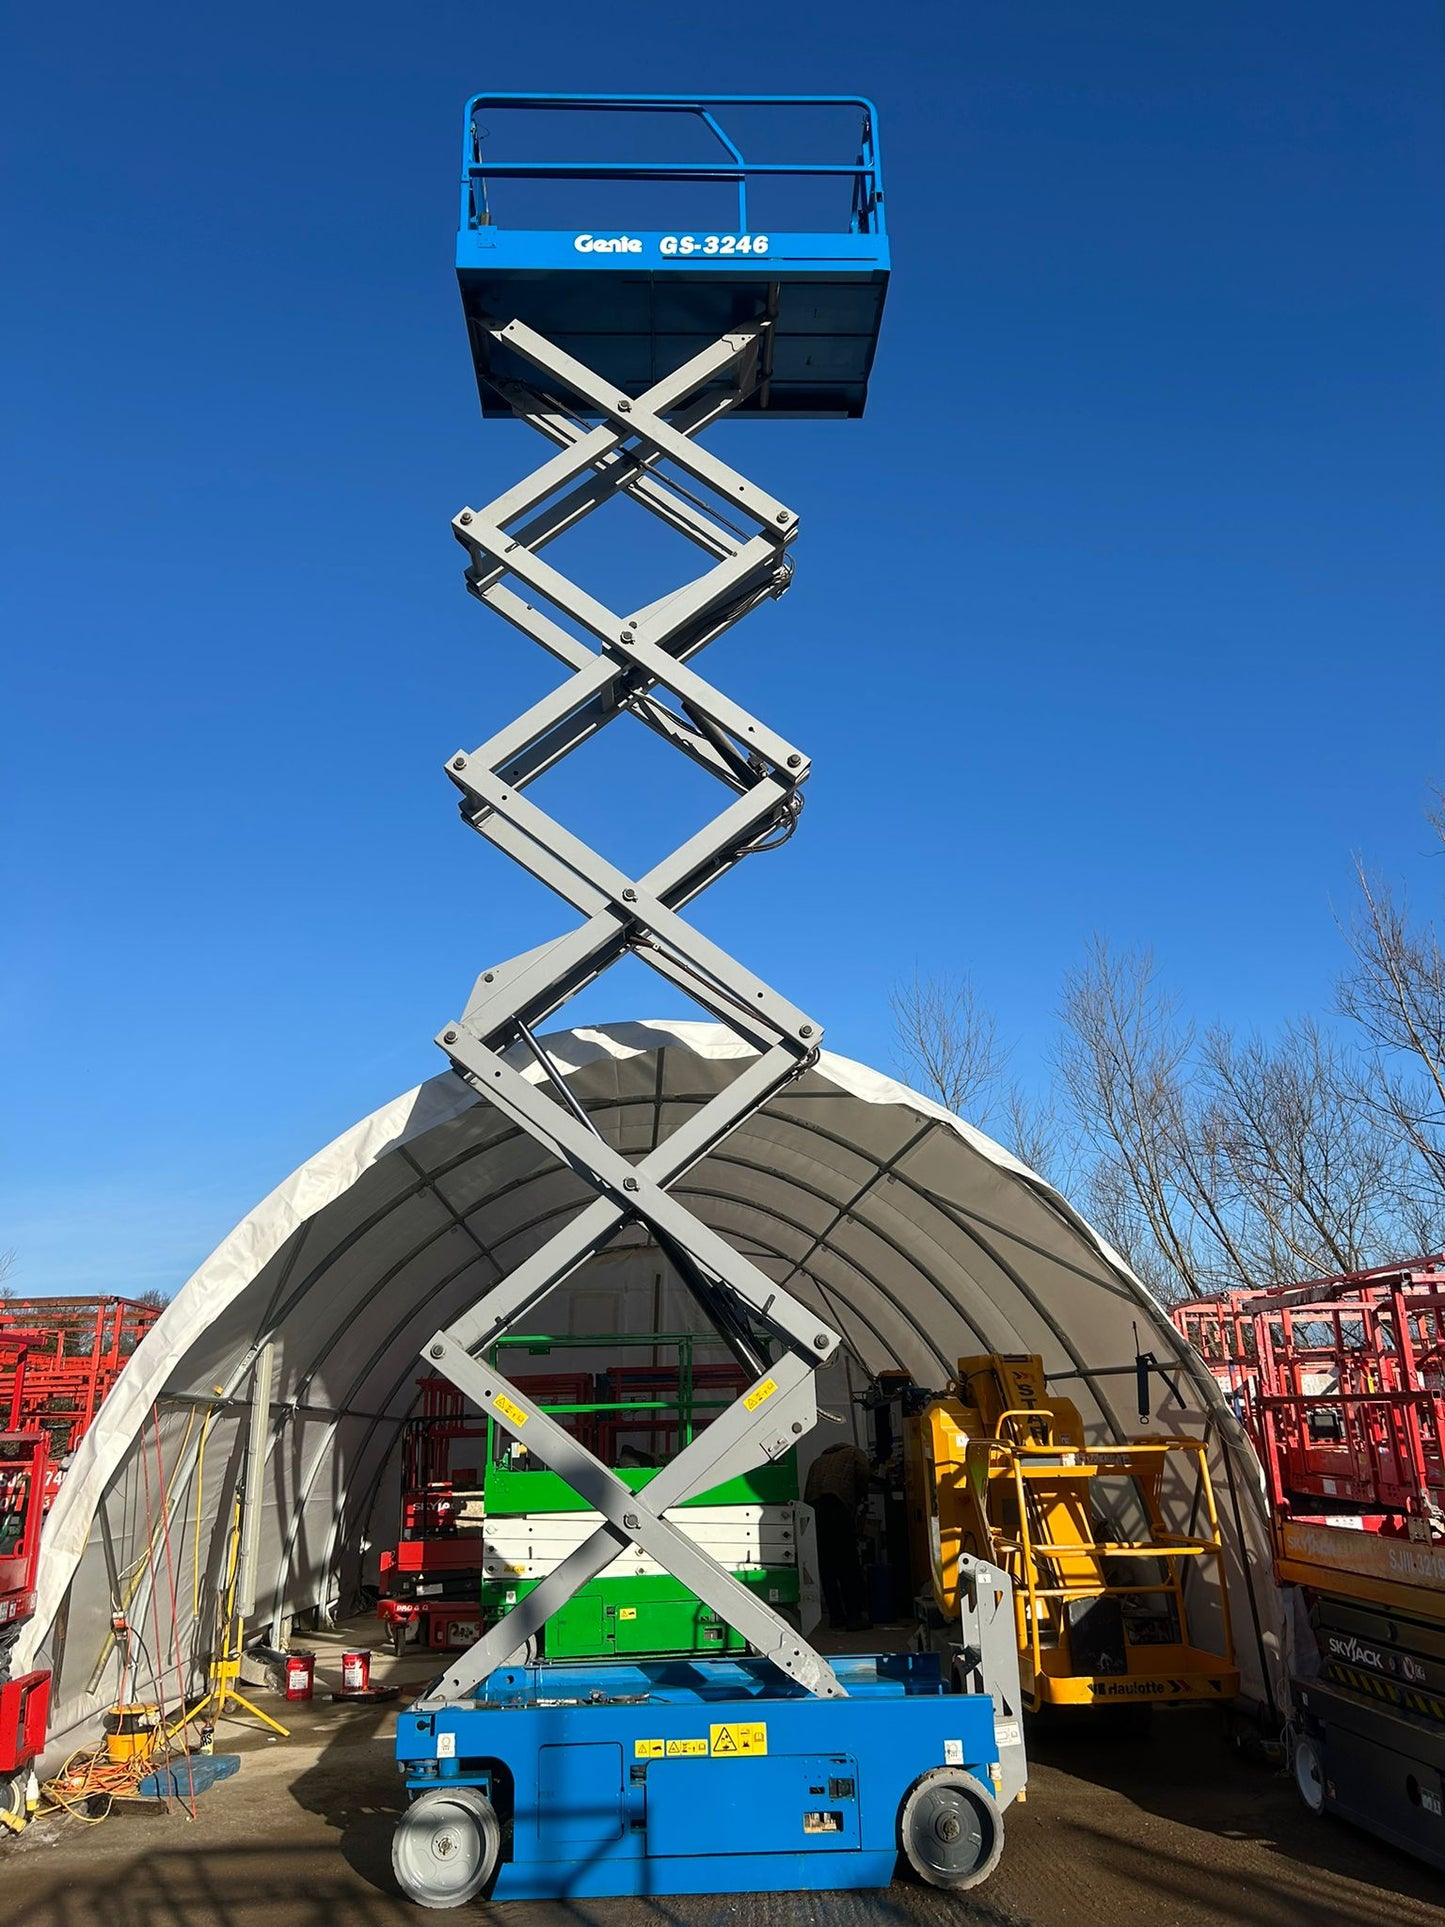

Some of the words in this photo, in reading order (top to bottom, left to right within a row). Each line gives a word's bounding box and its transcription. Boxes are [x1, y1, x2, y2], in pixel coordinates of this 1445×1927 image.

[574, 234, 643, 253] Genie
[659, 235, 769, 255] GS-3246
[1328, 1637, 1385, 1670] SKYJACK
[1108, 1681, 1165, 1695] Haulotte
